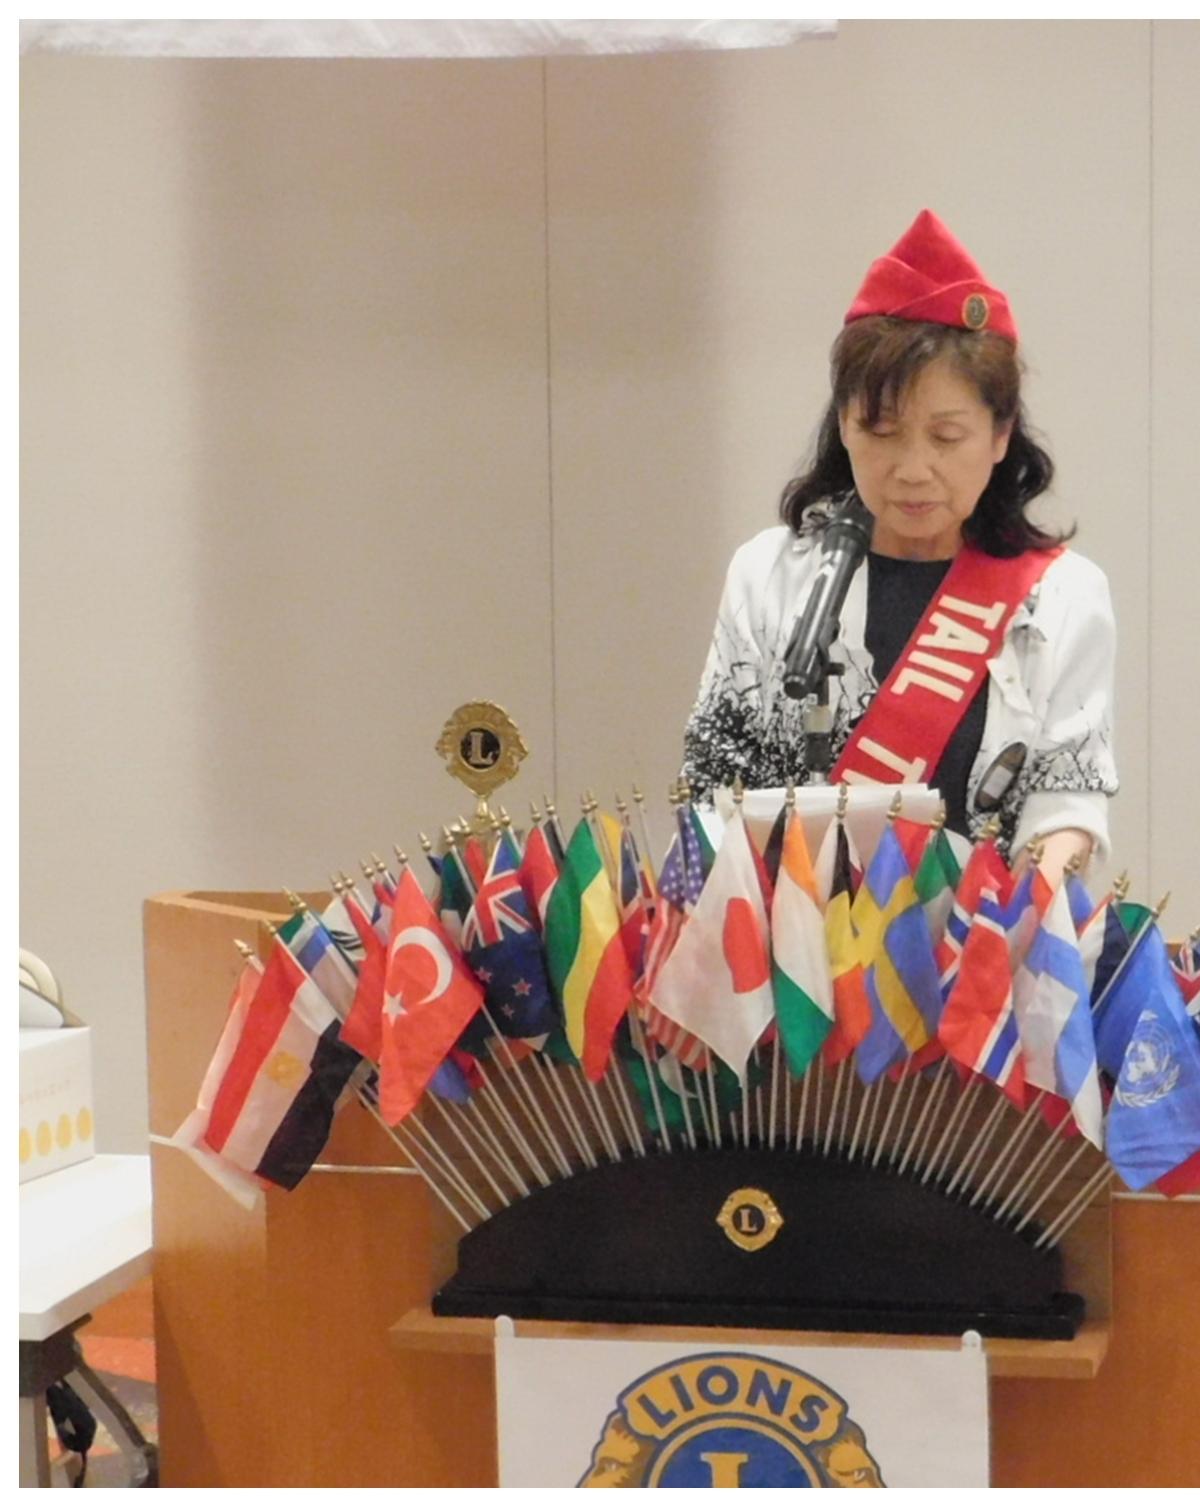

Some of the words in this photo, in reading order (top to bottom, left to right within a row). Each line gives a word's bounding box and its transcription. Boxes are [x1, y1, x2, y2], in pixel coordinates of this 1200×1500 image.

[890, 594, 1007, 703] TAIL
[468, 731, 494, 764] L
[740, 1208, 757, 1232] L
[636, 1365, 829, 1433] LIONS
